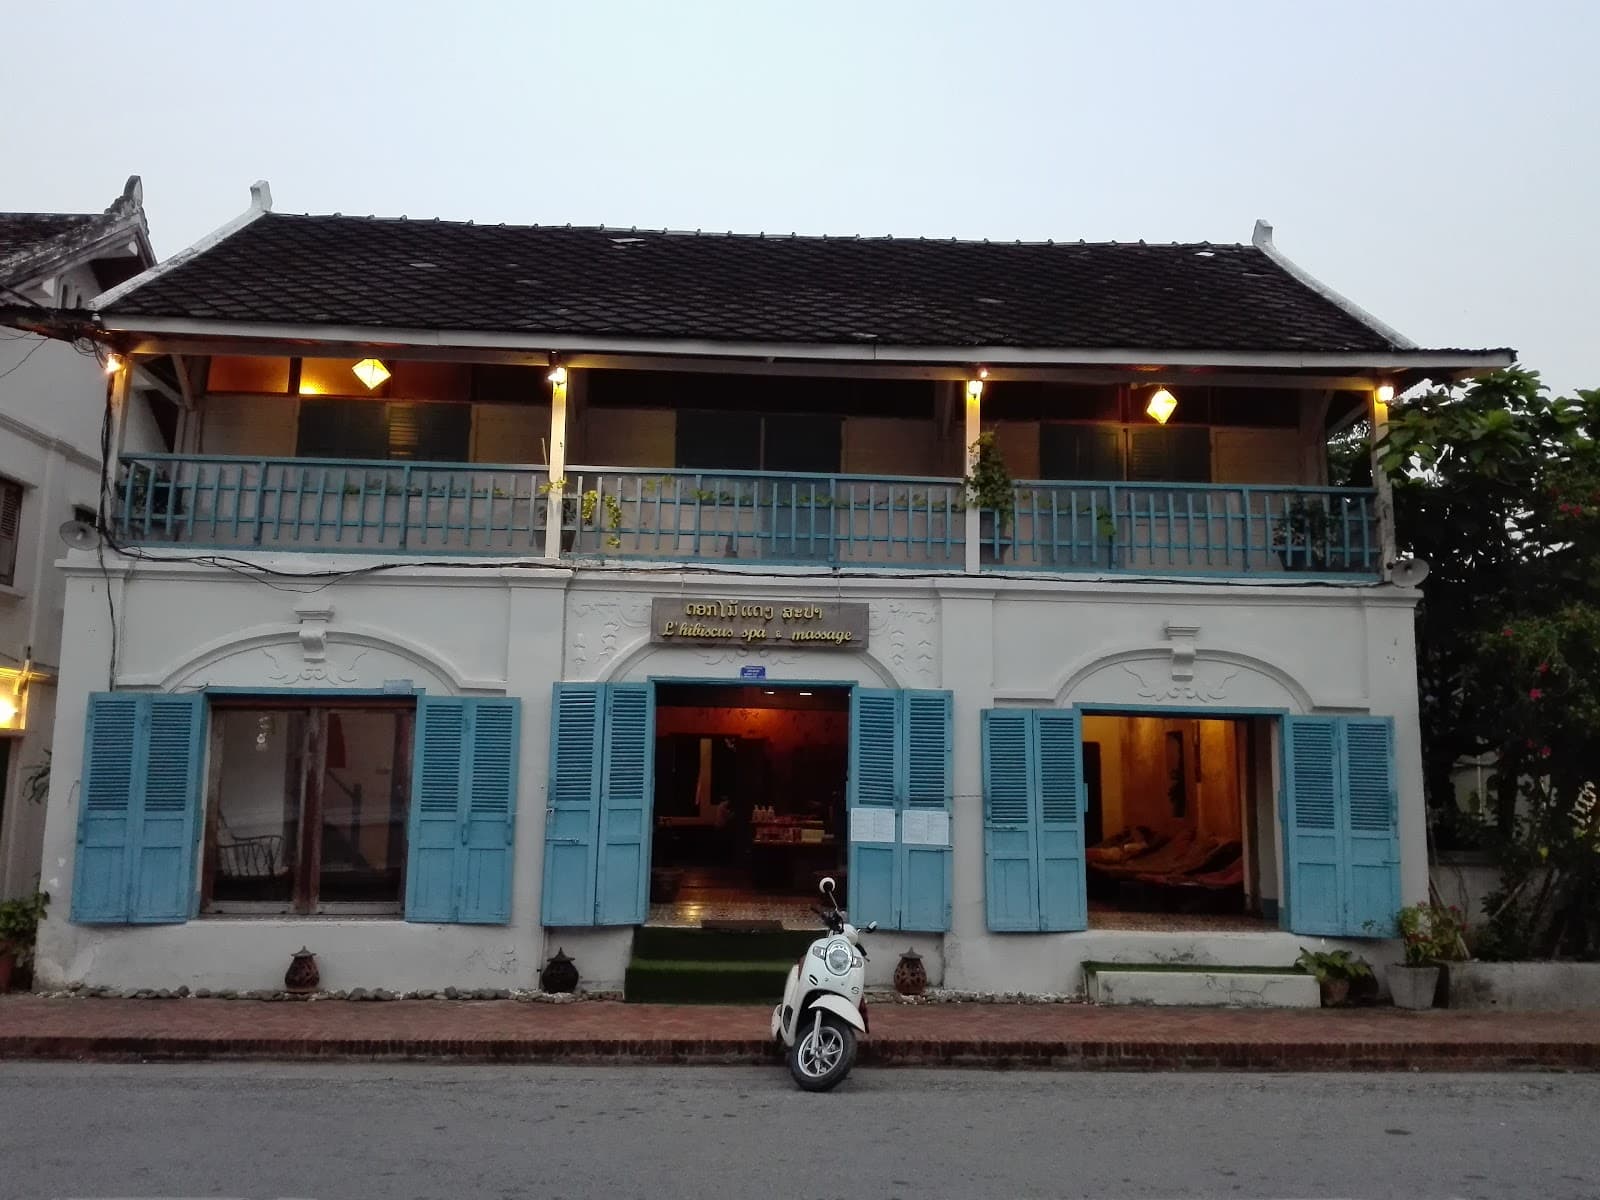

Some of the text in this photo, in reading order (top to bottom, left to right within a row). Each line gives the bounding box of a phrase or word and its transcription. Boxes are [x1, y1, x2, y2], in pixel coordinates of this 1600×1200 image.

[662, 621, 734, 638] L'hibiscus
[740, 627, 766, 642] spa
[791, 630, 853, 645] massage
